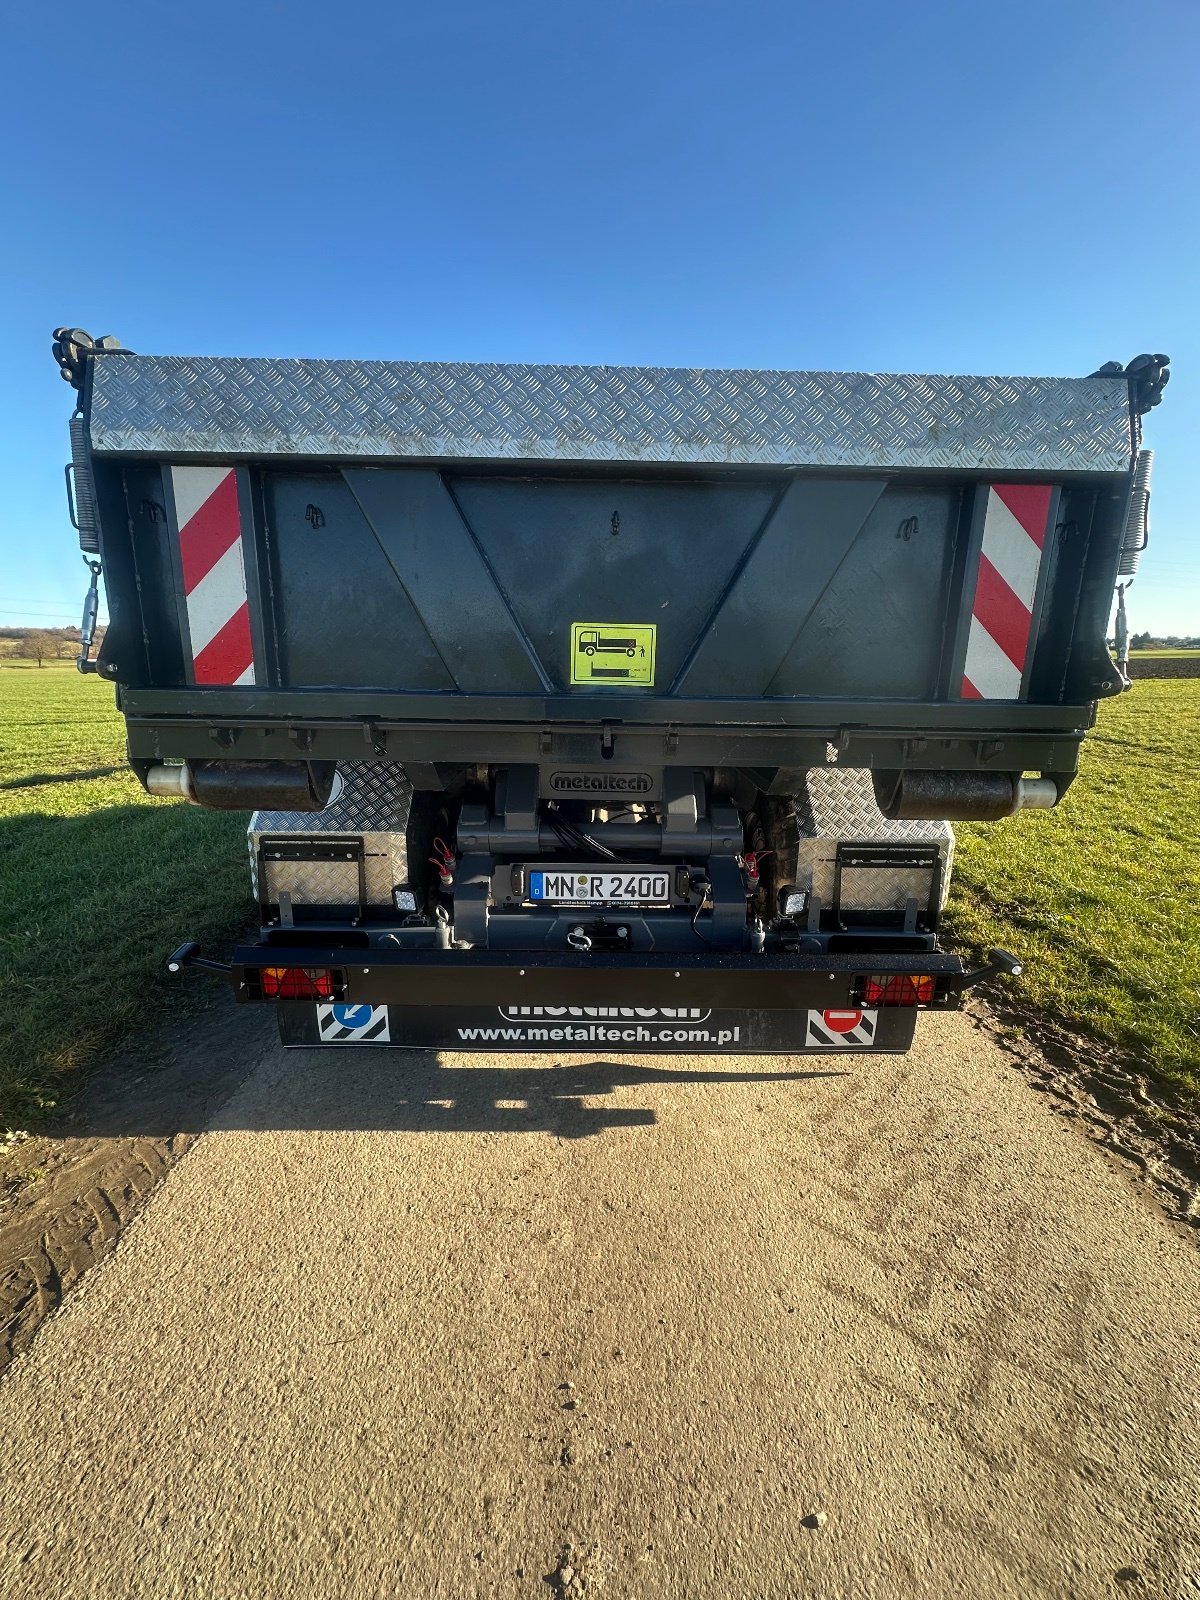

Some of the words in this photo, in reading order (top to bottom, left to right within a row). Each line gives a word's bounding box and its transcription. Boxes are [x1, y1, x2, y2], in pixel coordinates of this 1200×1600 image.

[554, 774, 648, 790] metaltech
[545, 876, 574, 897] MN
[590, 876, 604, 898] R
[609, 876, 666, 898] 2400
[457, 1025, 740, 1045] www.metaltech.com.pl
